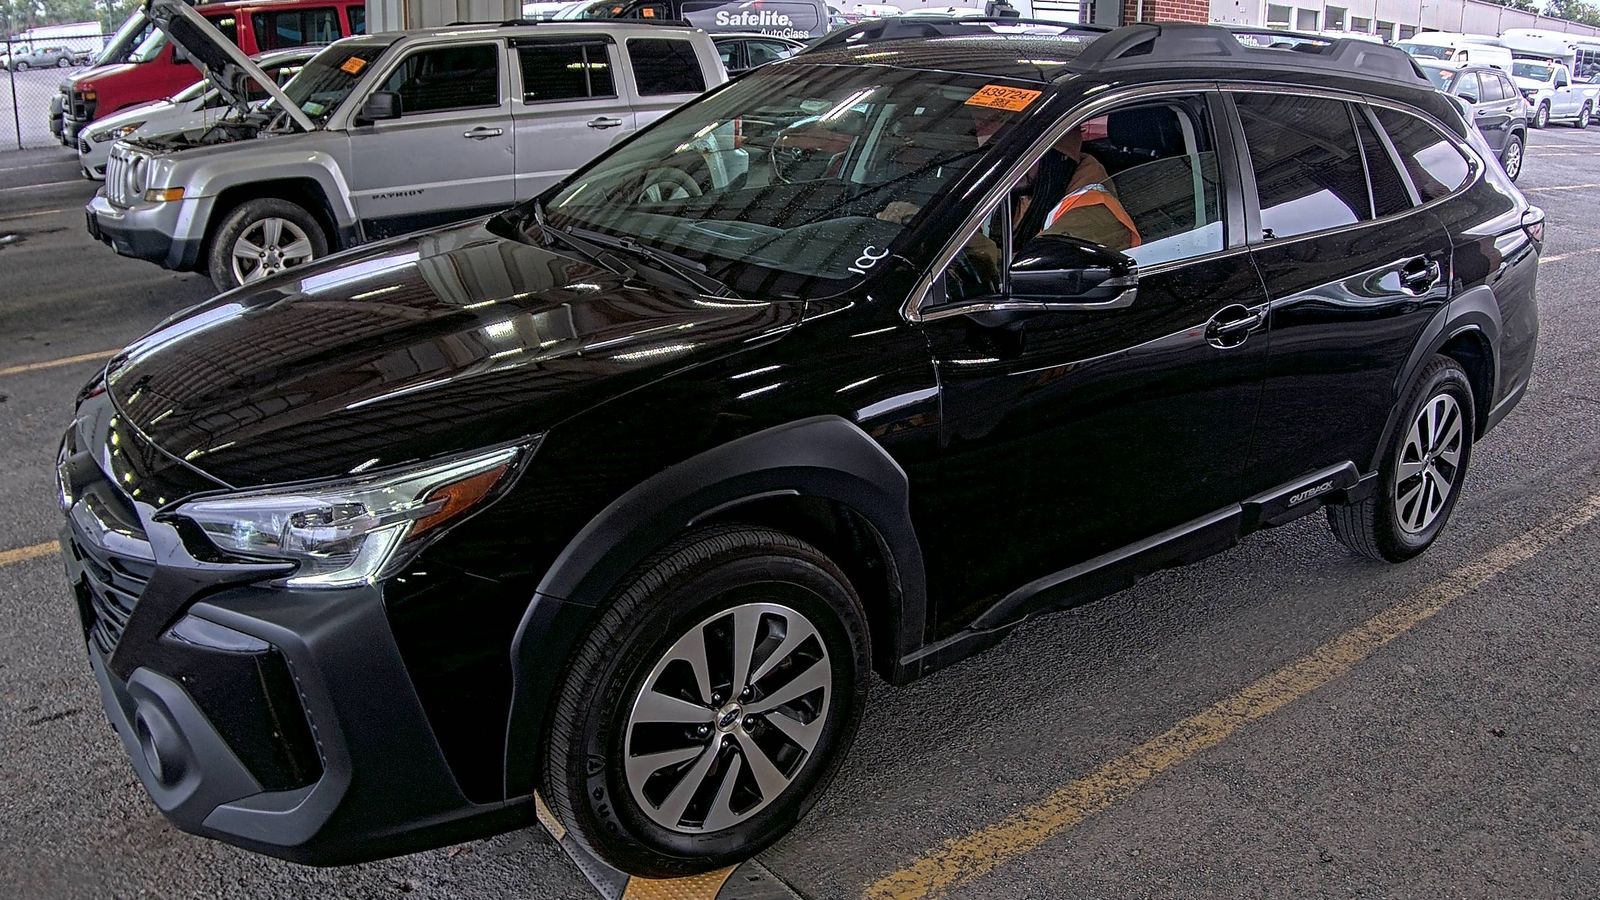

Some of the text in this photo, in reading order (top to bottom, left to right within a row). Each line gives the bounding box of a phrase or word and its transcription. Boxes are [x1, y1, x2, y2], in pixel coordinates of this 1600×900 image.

[760, 27, 809, 39] AutoGlass
[372, 189, 425, 200] PATRIOT
[1289, 480, 1333, 504] OUTBACK
